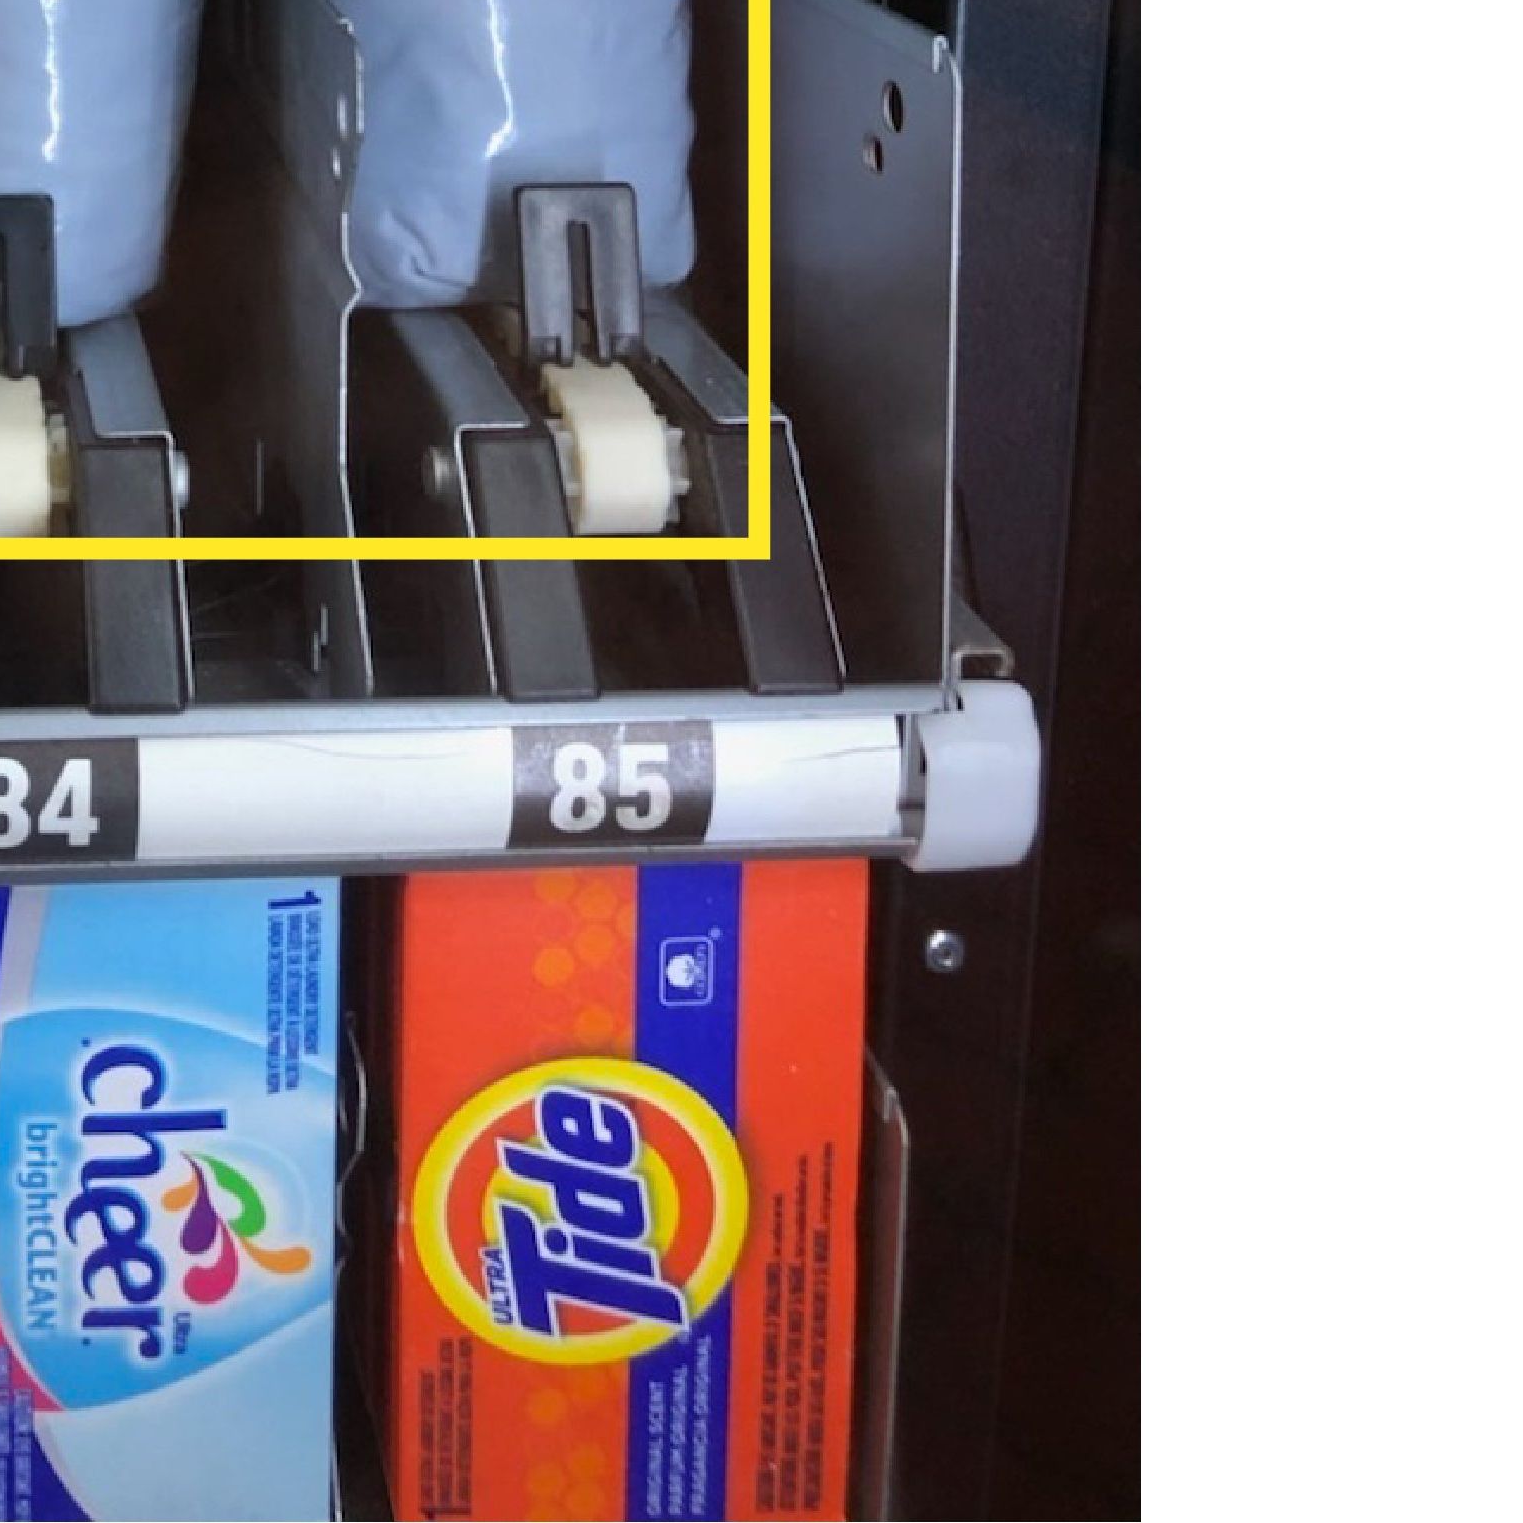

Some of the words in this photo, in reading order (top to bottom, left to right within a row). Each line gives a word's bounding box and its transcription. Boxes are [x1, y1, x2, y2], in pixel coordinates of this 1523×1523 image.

[549, 741, 672, 834] 85
[267, 890, 323, 910] 1
[16, 1122, 58, 1332] brightCLEAN
[64, 1044, 228, 1359] cheer
[495, 1083, 689, 1339] Tide
[481, 1248, 514, 1324] ULTRA
